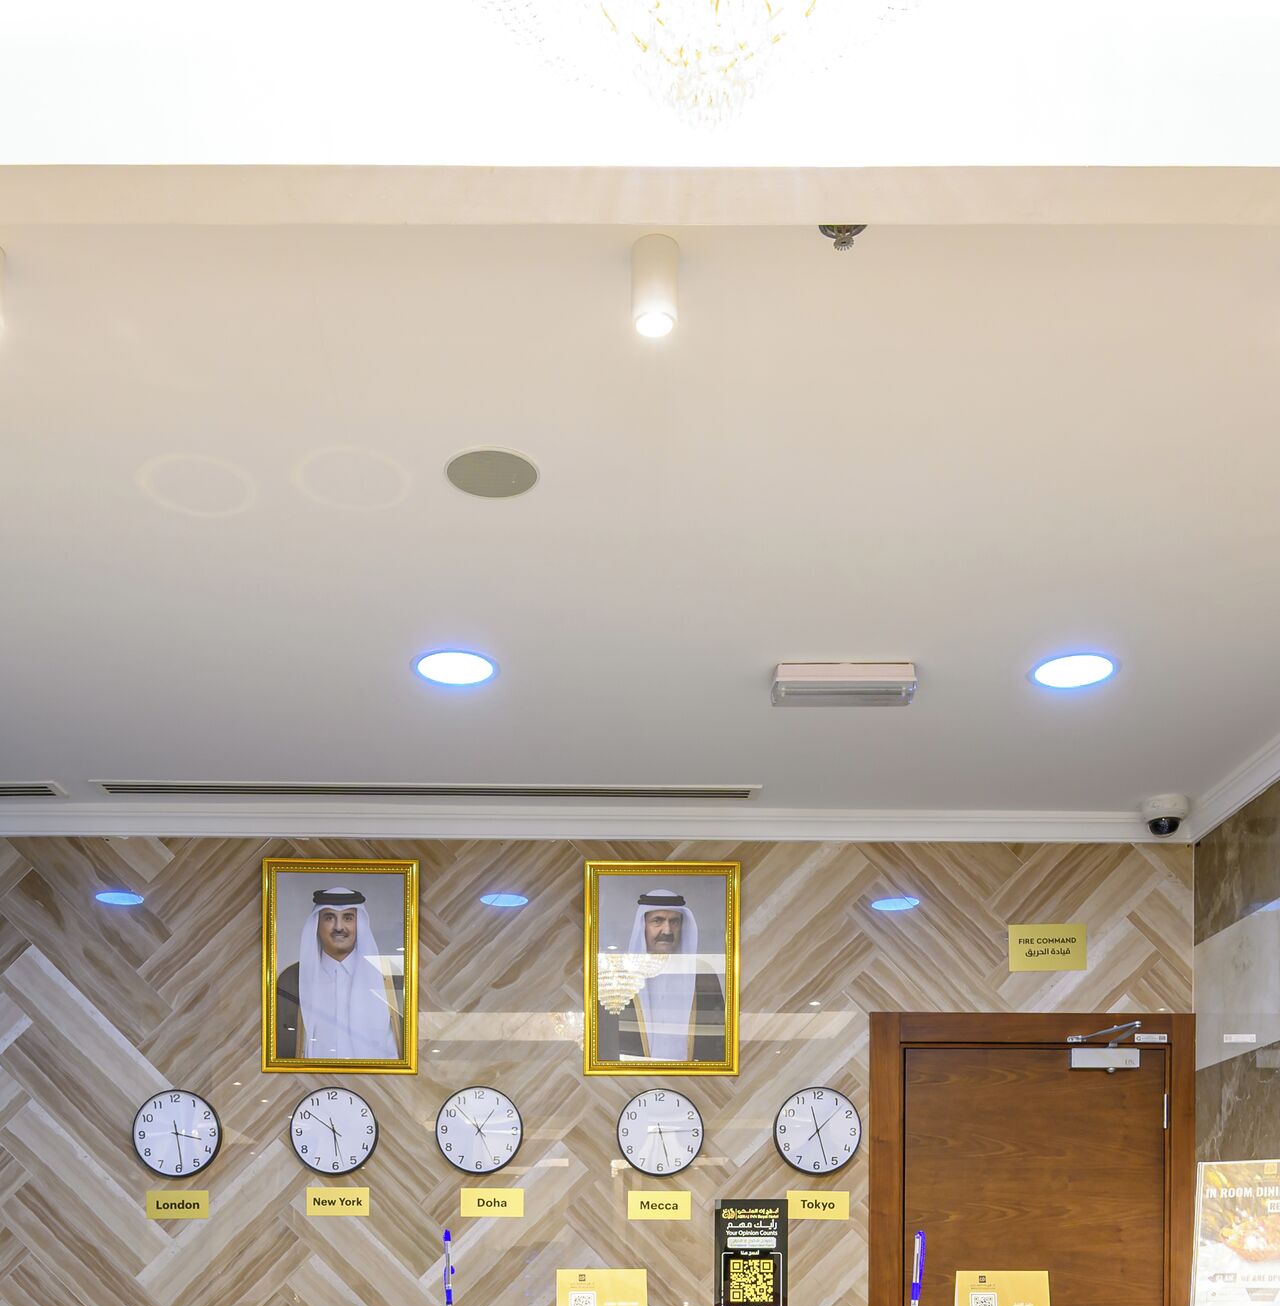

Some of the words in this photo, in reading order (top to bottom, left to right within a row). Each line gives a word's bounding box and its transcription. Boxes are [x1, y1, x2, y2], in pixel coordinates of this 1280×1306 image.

[1036, 937, 1077, 945] COMMAND
[1025, 948, 1049, 957] الحريق
[1050, 947, 1071, 956] قيادة
[170, 1094, 180, 1102] 12
[327, 1092, 338, 1100] 12
[474, 1091, 484, 1099] 12
[655, 1093, 664, 1101] 12
[813, 1091, 823, 1099] 12
[154, 1101, 162, 1109] 11
[311, 1098, 319, 1106] 11
[638, 1099, 646, 1107] 11
[204, 1111, 210, 1119] 2
[300, 1111, 310, 1119] 10
[361, 1109, 367, 1117] 2
[446, 1109, 456, 1117] 10
[507, 1109, 513, 1118] 2
[627, 1112, 637, 1120] 10
[688, 1111, 694, 1119] 2
[785, 1109, 795, 1117] 10
[846, 1110, 852, 1118] 2
[143, 1114, 153, 1122] 10
[209, 1128, 216, 1136] 3
[296, 1128, 302, 1136] 9
[367, 1126, 373, 1134] 3
[441, 1125, 447, 1134] 9
[512, 1127, 518, 1135] 3
[622, 1128, 628, 1136] 9
[692, 1129, 699, 1137] 3
[780, 1125, 786, 1134] 9
[850, 1128, 856, 1136] 3
[139, 1131, 145, 1139] 9
[301, 1145, 308, 1153] 8
[362, 1143, 368, 1151] 4
[446, 1143, 452, 1151] 8
[506, 1144, 512, 1152] 4
[627, 1146, 633, 1154] 8
[784, 1143, 790, 1151] 8
[844, 1144, 850, 1152] 4
[145, 1148, 151, 1156] 8
[158, 1160, 163, 1168] 7
[193, 1159, 200, 1167] 5
[315, 1157, 320, 1165] 7
[350, 1156, 356, 1164] 5
[459, 1156, 464, 1164] 7
[494, 1156, 500, 1164] 5
[640, 1158, 645, 1166] 7
[675, 1158, 681, 1166] 5
[796, 1156, 802, 1164] 7
[832, 1157, 838, 1165] 5
[176, 1164, 182, 1172] 6
[332, 1162, 339, 1170] 6
[475, 1161, 482, 1169] 6
[657, 1163, 663, 1171] 6
[1206, 1188, 1217, 1198] IN
[1220, 1187, 1253, 1199] ROOM
[155, 1198, 200, 1210] London
[313, 1197, 333, 1207] New
[334, 1197, 363, 1207] York
[477, 1198, 508, 1208] Doha
[640, 1200, 679, 1211] Mecca
[800, 1199, 835, 1212] Tokyo
